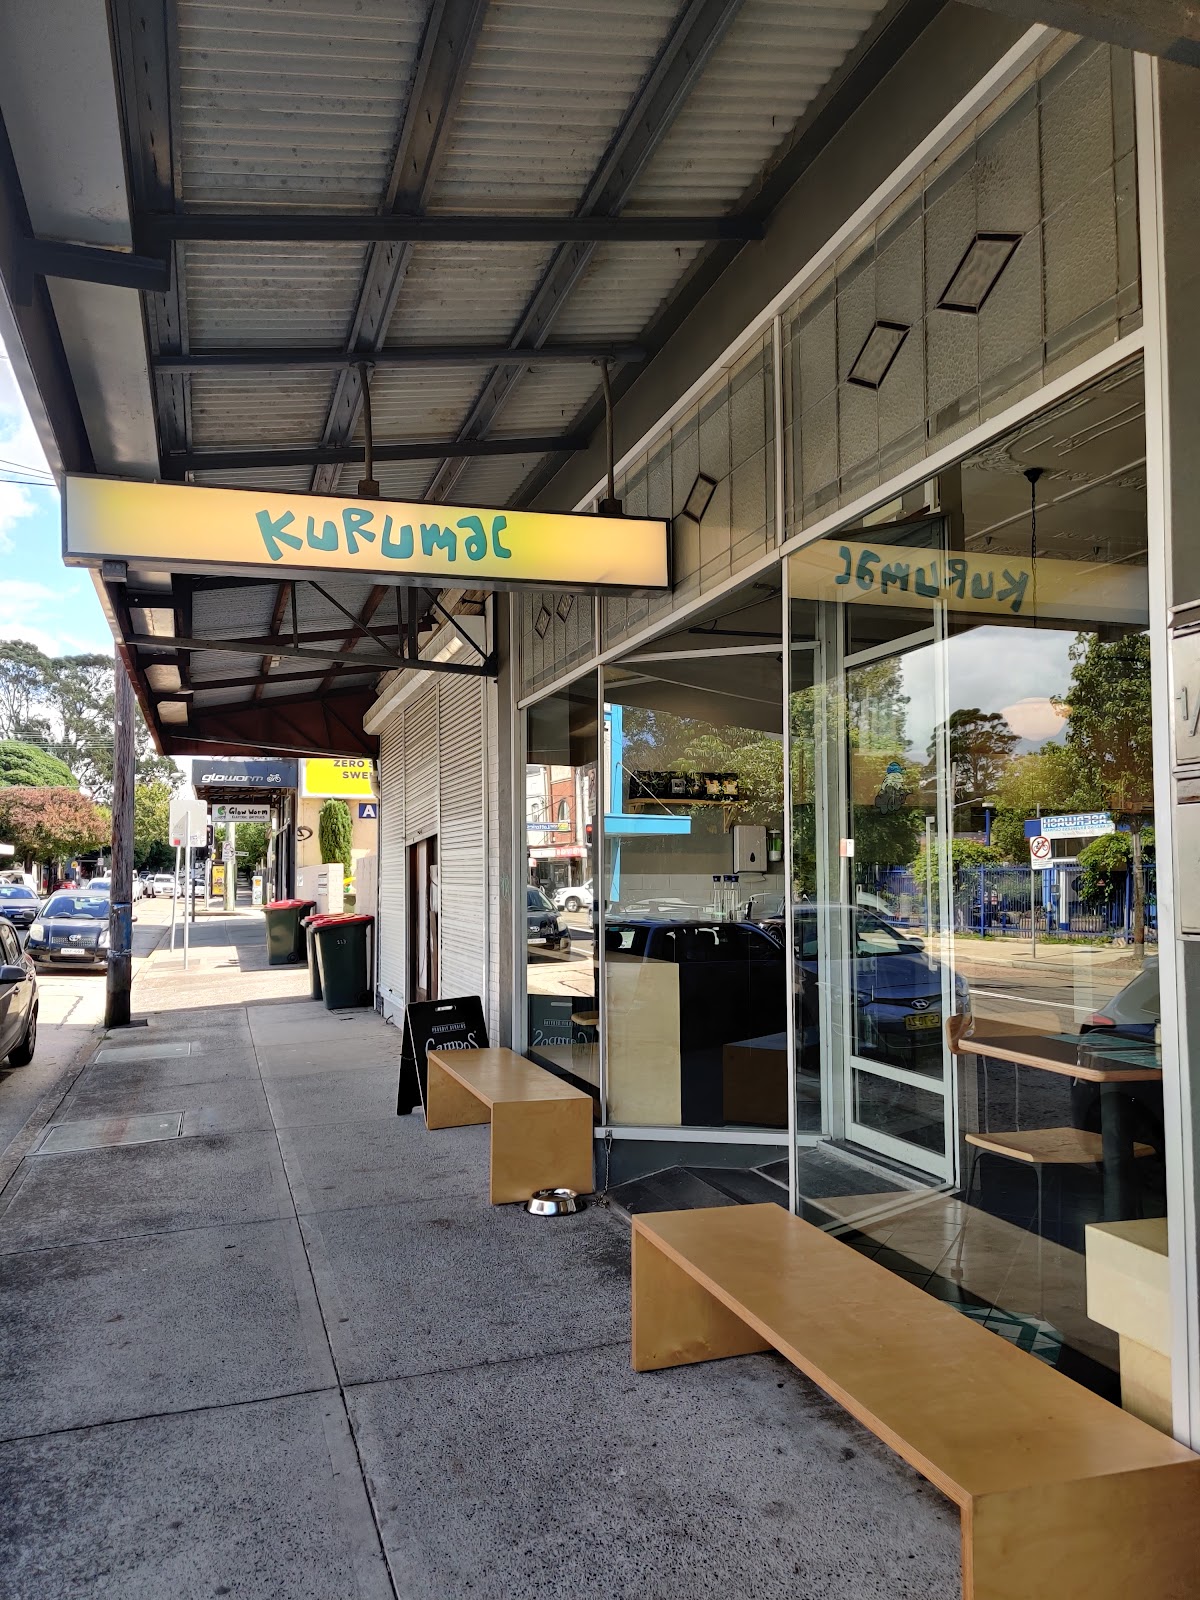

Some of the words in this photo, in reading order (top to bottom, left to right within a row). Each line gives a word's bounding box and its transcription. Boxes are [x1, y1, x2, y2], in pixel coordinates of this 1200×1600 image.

[333, 759, 365, 768] ZERO
[342, 771, 373, 779] SWE
[362, 804, 375, 818] A
